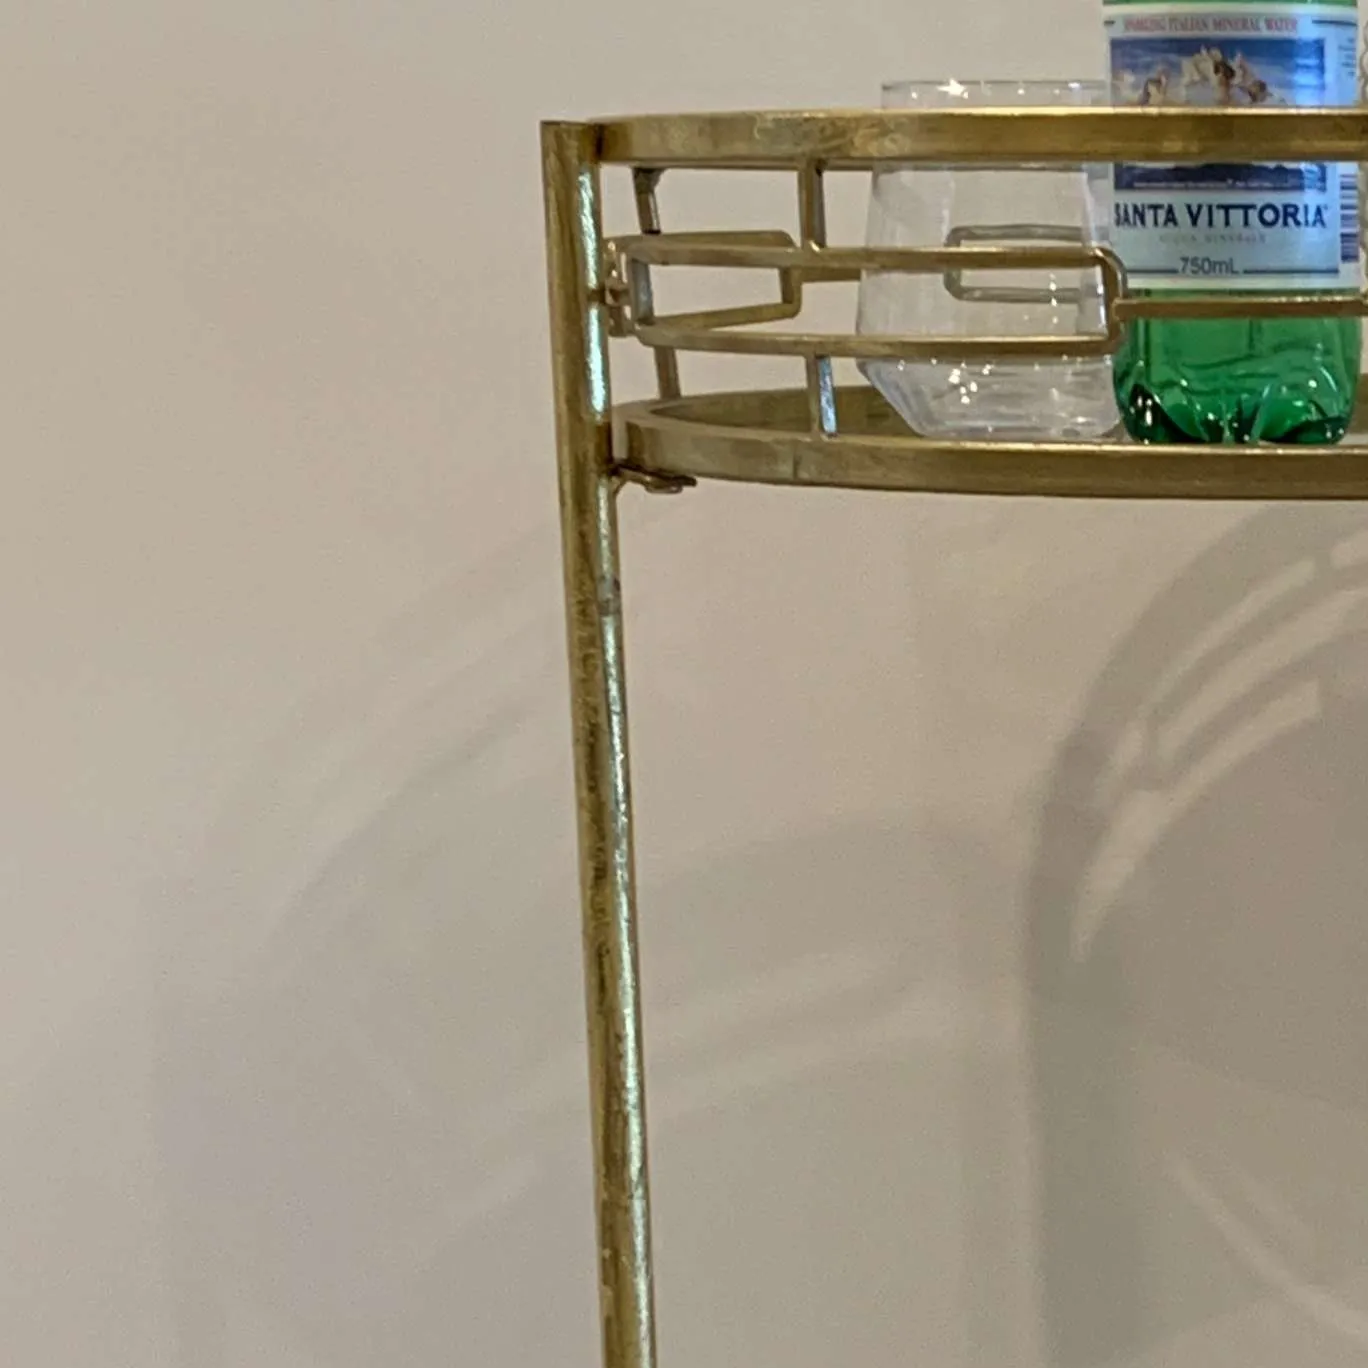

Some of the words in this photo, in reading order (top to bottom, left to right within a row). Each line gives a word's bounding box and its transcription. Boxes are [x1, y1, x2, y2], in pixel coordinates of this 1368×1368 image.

[1114, 202, 1178, 229] SANTA
[1185, 202, 1327, 230] VITTORIA
[1179, 256, 1240, 276] 750mL
